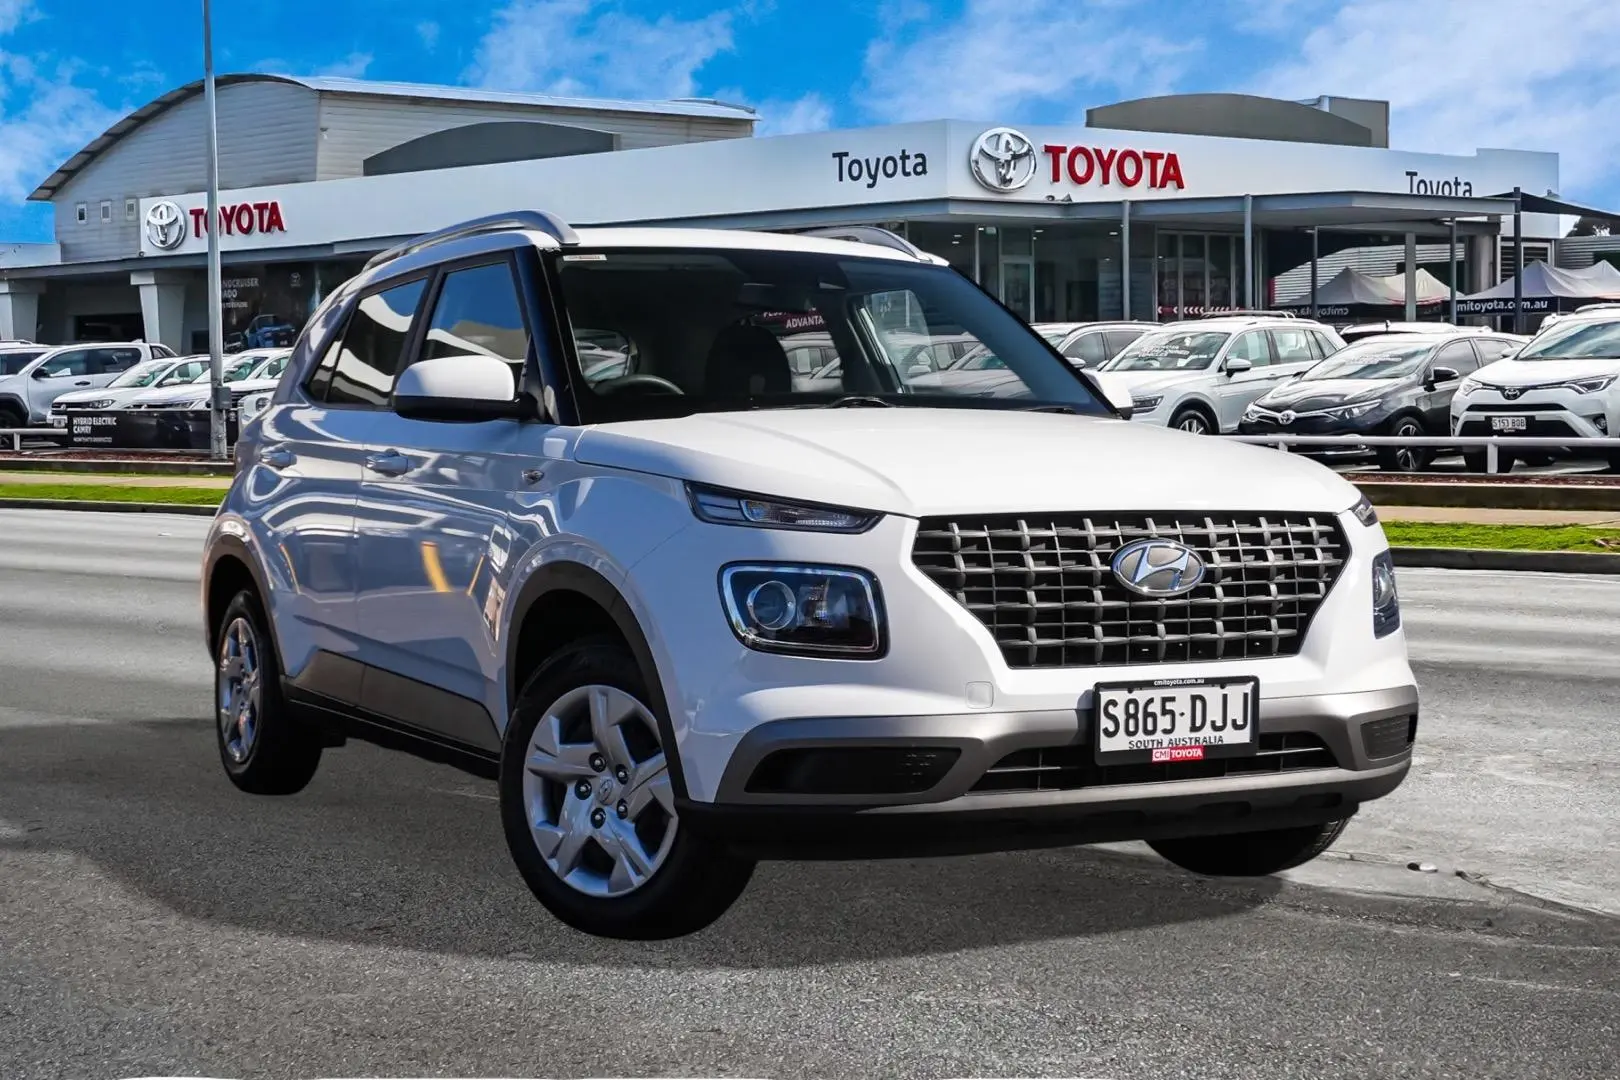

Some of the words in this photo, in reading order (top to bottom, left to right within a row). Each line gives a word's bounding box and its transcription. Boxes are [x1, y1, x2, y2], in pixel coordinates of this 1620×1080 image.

[832, 149, 928, 188] Toyota
[1044, 144, 1184, 190] TOYOTA
[223, 289, 238, 298] ADO
[1457, 300, 1548, 312] mitoyota.cm.au
[786, 315, 824, 328] ADVANTA
[1154, 678, 1204, 686] cmitoyota.com.au
[1128, 738, 1163, 749] SOUTH
[1168, 735, 1224, 748] AUSTRALIA
[1171, 748, 1203, 758] TOYOTA
